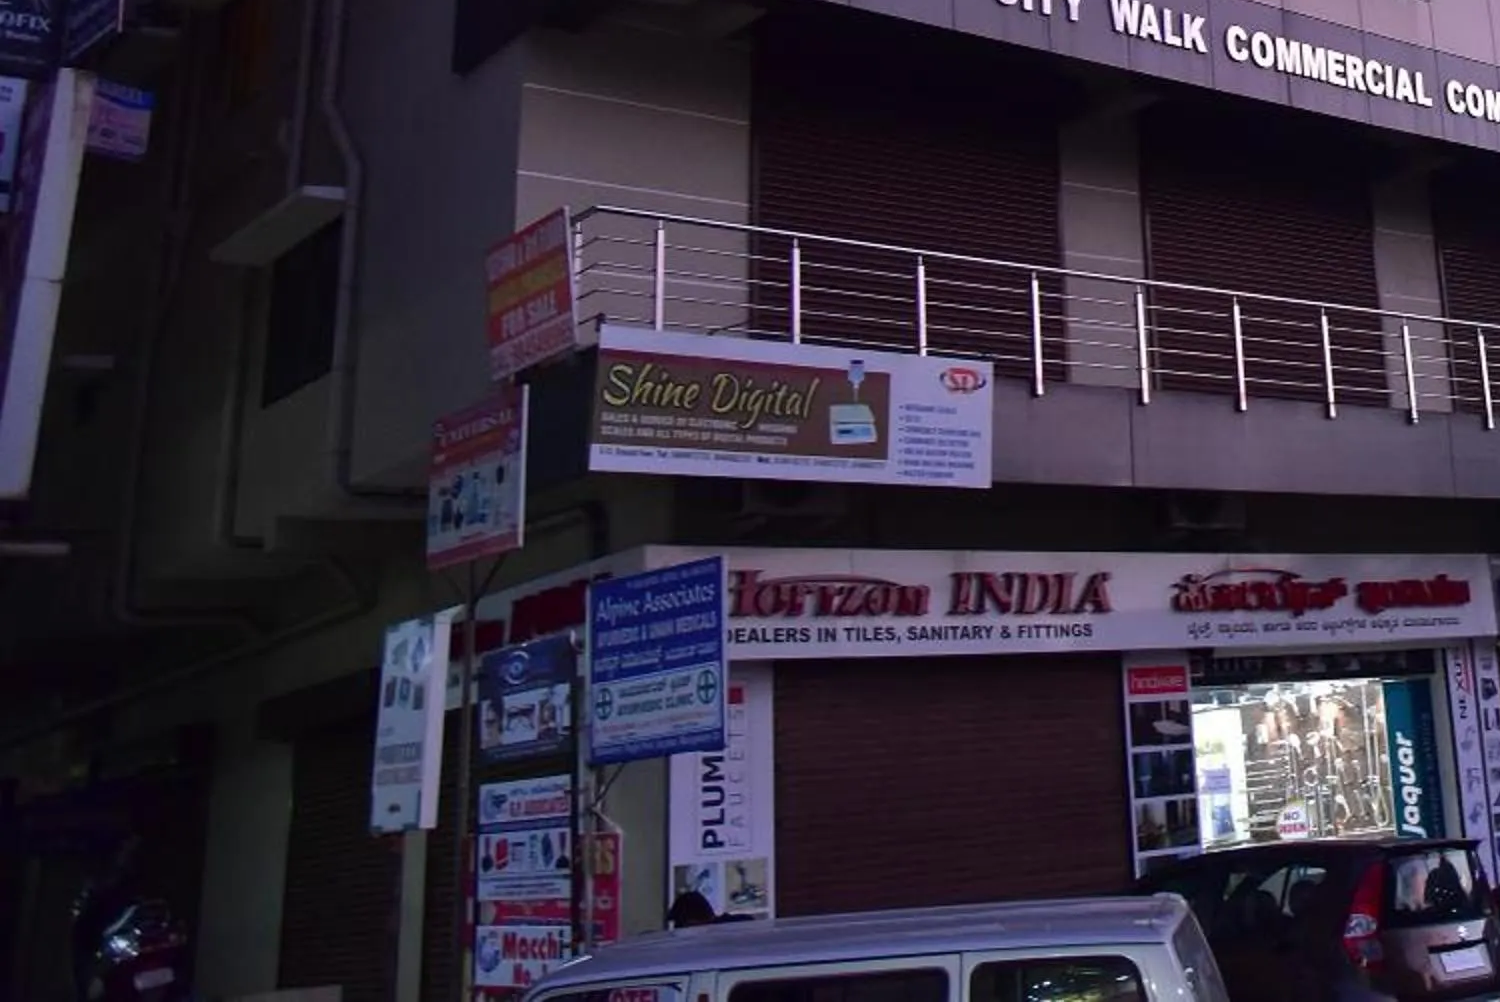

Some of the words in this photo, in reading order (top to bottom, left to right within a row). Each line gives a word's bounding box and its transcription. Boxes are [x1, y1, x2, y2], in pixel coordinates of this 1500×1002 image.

[1226, 24, 1433, 107] COMMERCIAL
[602, 363, 700, 410] Shine
[711, 373, 820, 429] Digital
[642, 582, 717, 613] Associates
[946, 571, 1113, 616] INDIA
[817, 627, 836, 643] IN
[846, 626, 901, 644] TILES,
[907, 625, 993, 641] SANITARY
[1000, 624, 1011, 640] &
[1017, 622, 1093, 640] FITTINGS
[727, 708, 745, 847] FAUCETS
[1396, 731, 1427, 839] Jaquar
